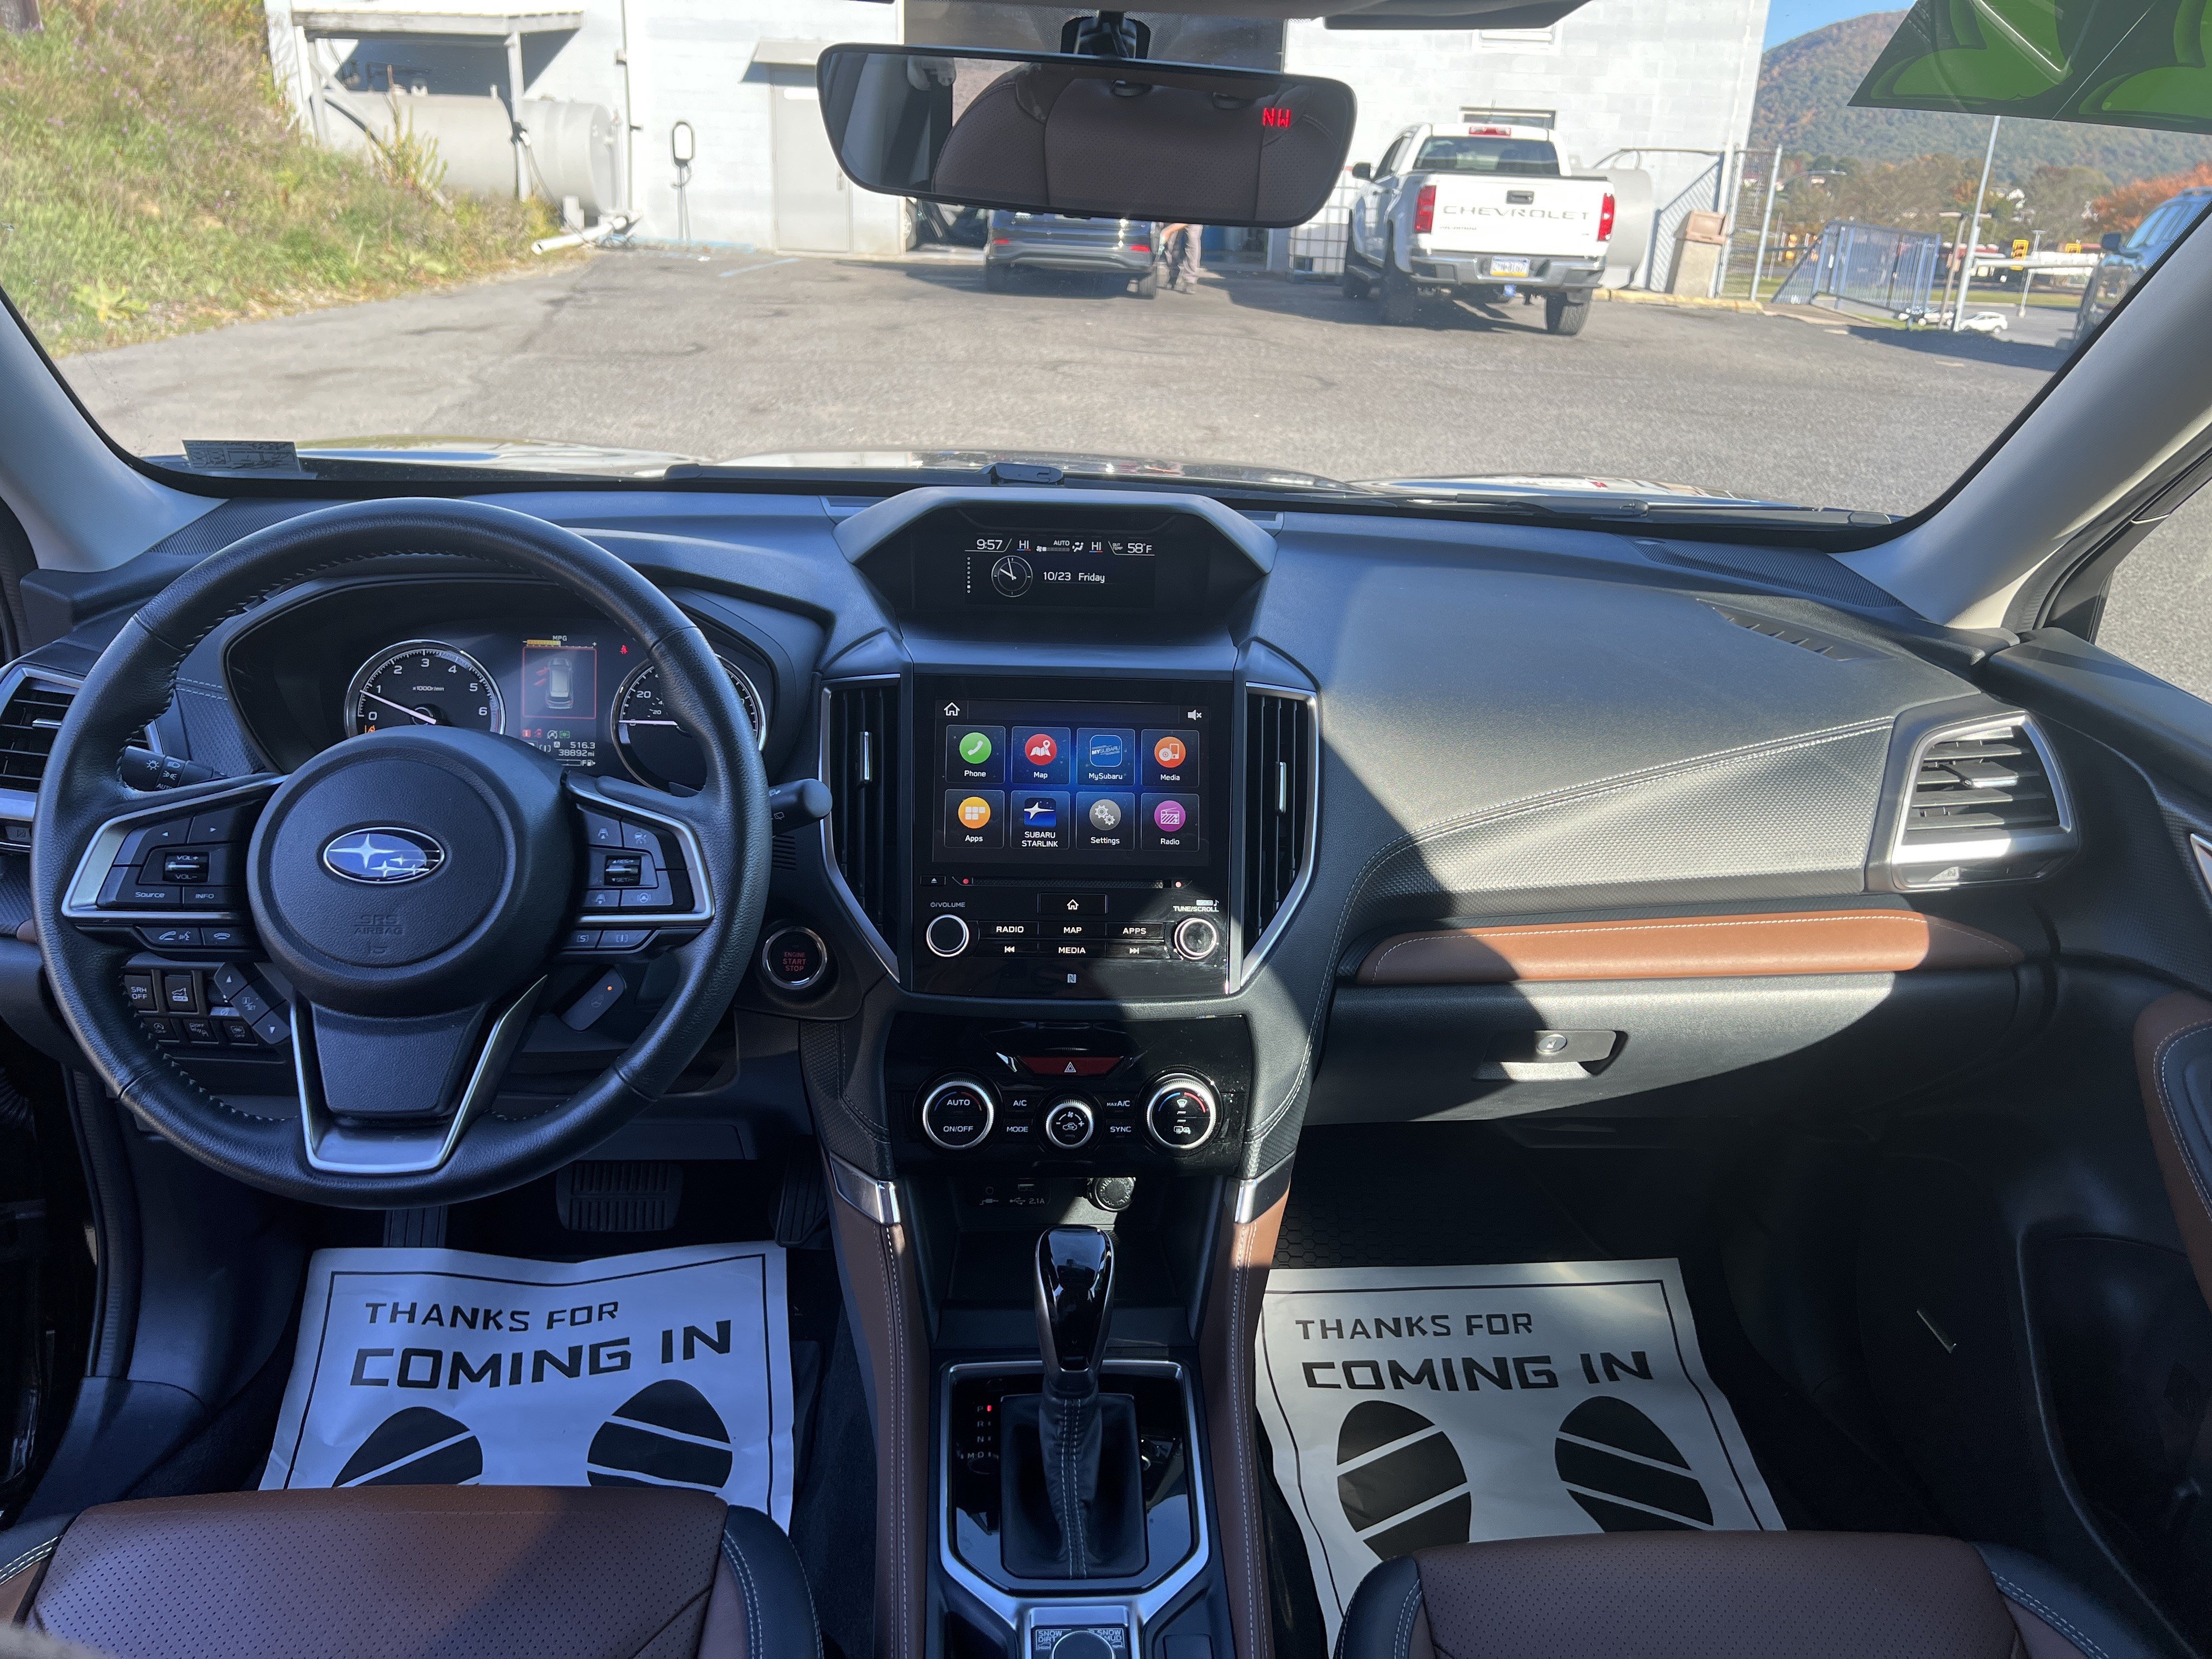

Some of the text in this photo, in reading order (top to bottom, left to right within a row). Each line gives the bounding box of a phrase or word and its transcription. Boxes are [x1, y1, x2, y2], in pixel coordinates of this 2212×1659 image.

[1263, 107, 1291, 128] NW
[1443, 206, 1589, 220] CHEVROLET
[977, 539, 1003, 550] 9:57
[1019, 540, 1029, 549] HI
[1091, 541, 1102, 550] HI
[1043, 572, 1105, 583] 10/23 Friday
[421, 658, 430, 667] 3
[393, 665, 403, 674] 2
[448, 665, 456, 674] 4
[376, 685, 381, 693] 1
[470, 683, 478, 692] 5
[368, 712, 377, 720] 0
[479, 707, 488, 716] 6
[965, 835, 983, 844] Apps
[1091, 837, 1120, 845] Settings
[943, 1125, 974, 1133] ON/OFF
[365, 1301, 619, 1332] THANKS FOR
[1295, 1313, 1532, 1340] THANKS FOR
[350, 1320, 731, 1390] COMING IN
[1302, 1351, 1654, 1391] COMING IN
